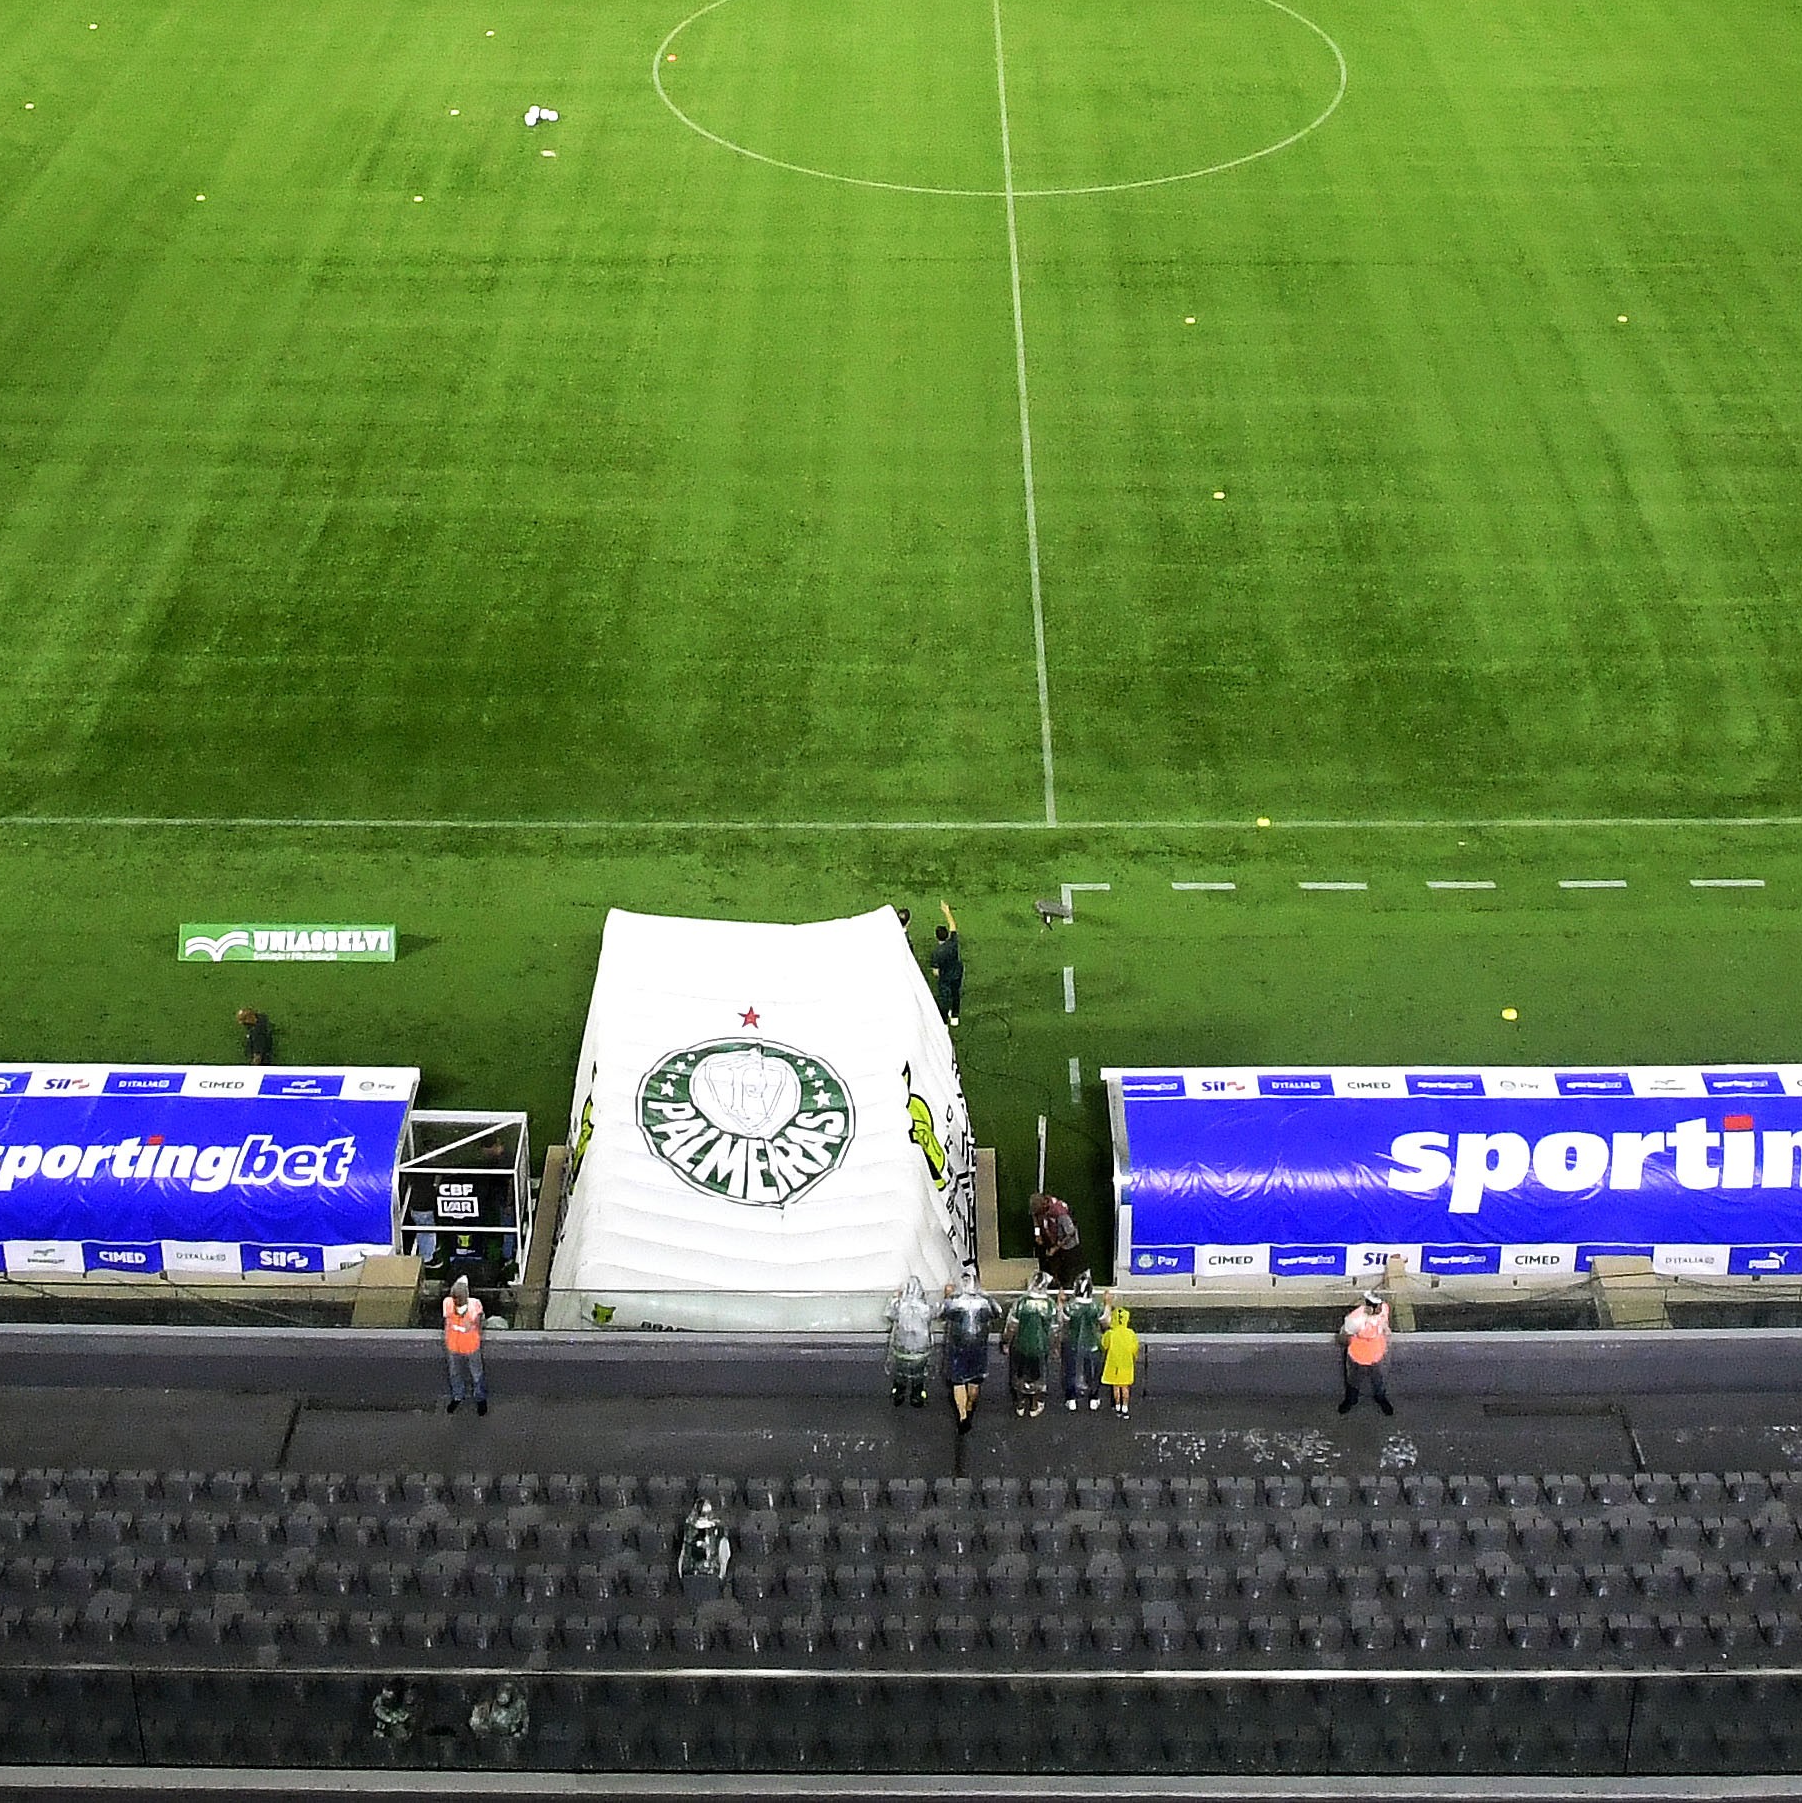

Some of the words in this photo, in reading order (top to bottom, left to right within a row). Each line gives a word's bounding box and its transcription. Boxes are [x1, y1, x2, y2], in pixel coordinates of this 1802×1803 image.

[253, 930, 391, 952] UNIASSELVI
[199, 1080, 245, 1090] CIMED
[439, 1183, 474, 1196] CBF
[443, 1201, 472, 1213] VAR
[99, 1250, 147, 1264] CIMED
[1157, 1255, 1179, 1267] Pay
[1208, 1255, 1254, 1265] CIMED
[1514, 1255, 1560, 1265] CIMED
